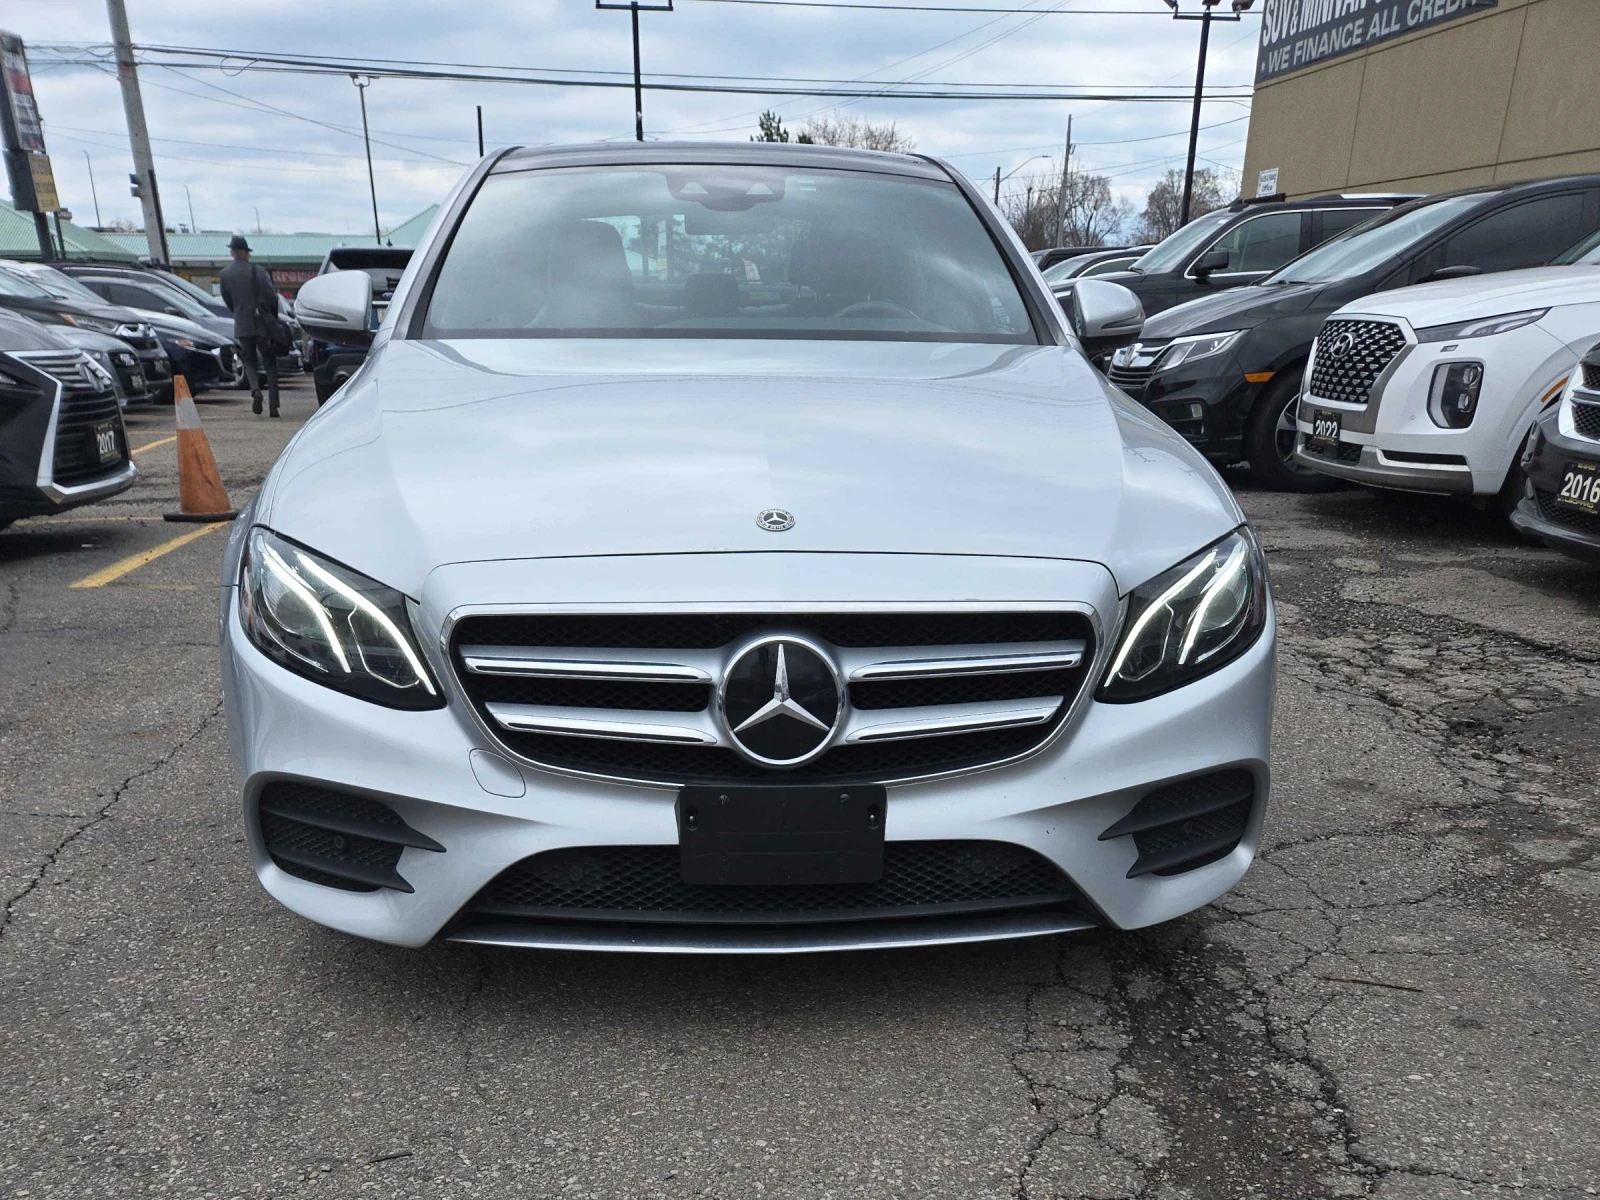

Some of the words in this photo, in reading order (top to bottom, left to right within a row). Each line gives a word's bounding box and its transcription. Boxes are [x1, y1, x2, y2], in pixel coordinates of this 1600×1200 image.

[1268, 45, 1291, 73] WE
[1293, 18, 1365, 65] FINANCE
[1366, 6, 1401, 41] ALL
[97, 430, 115, 454] 2017
[1315, 419, 1338, 438] 2022
[1560, 472, 1600, 503] 2016
